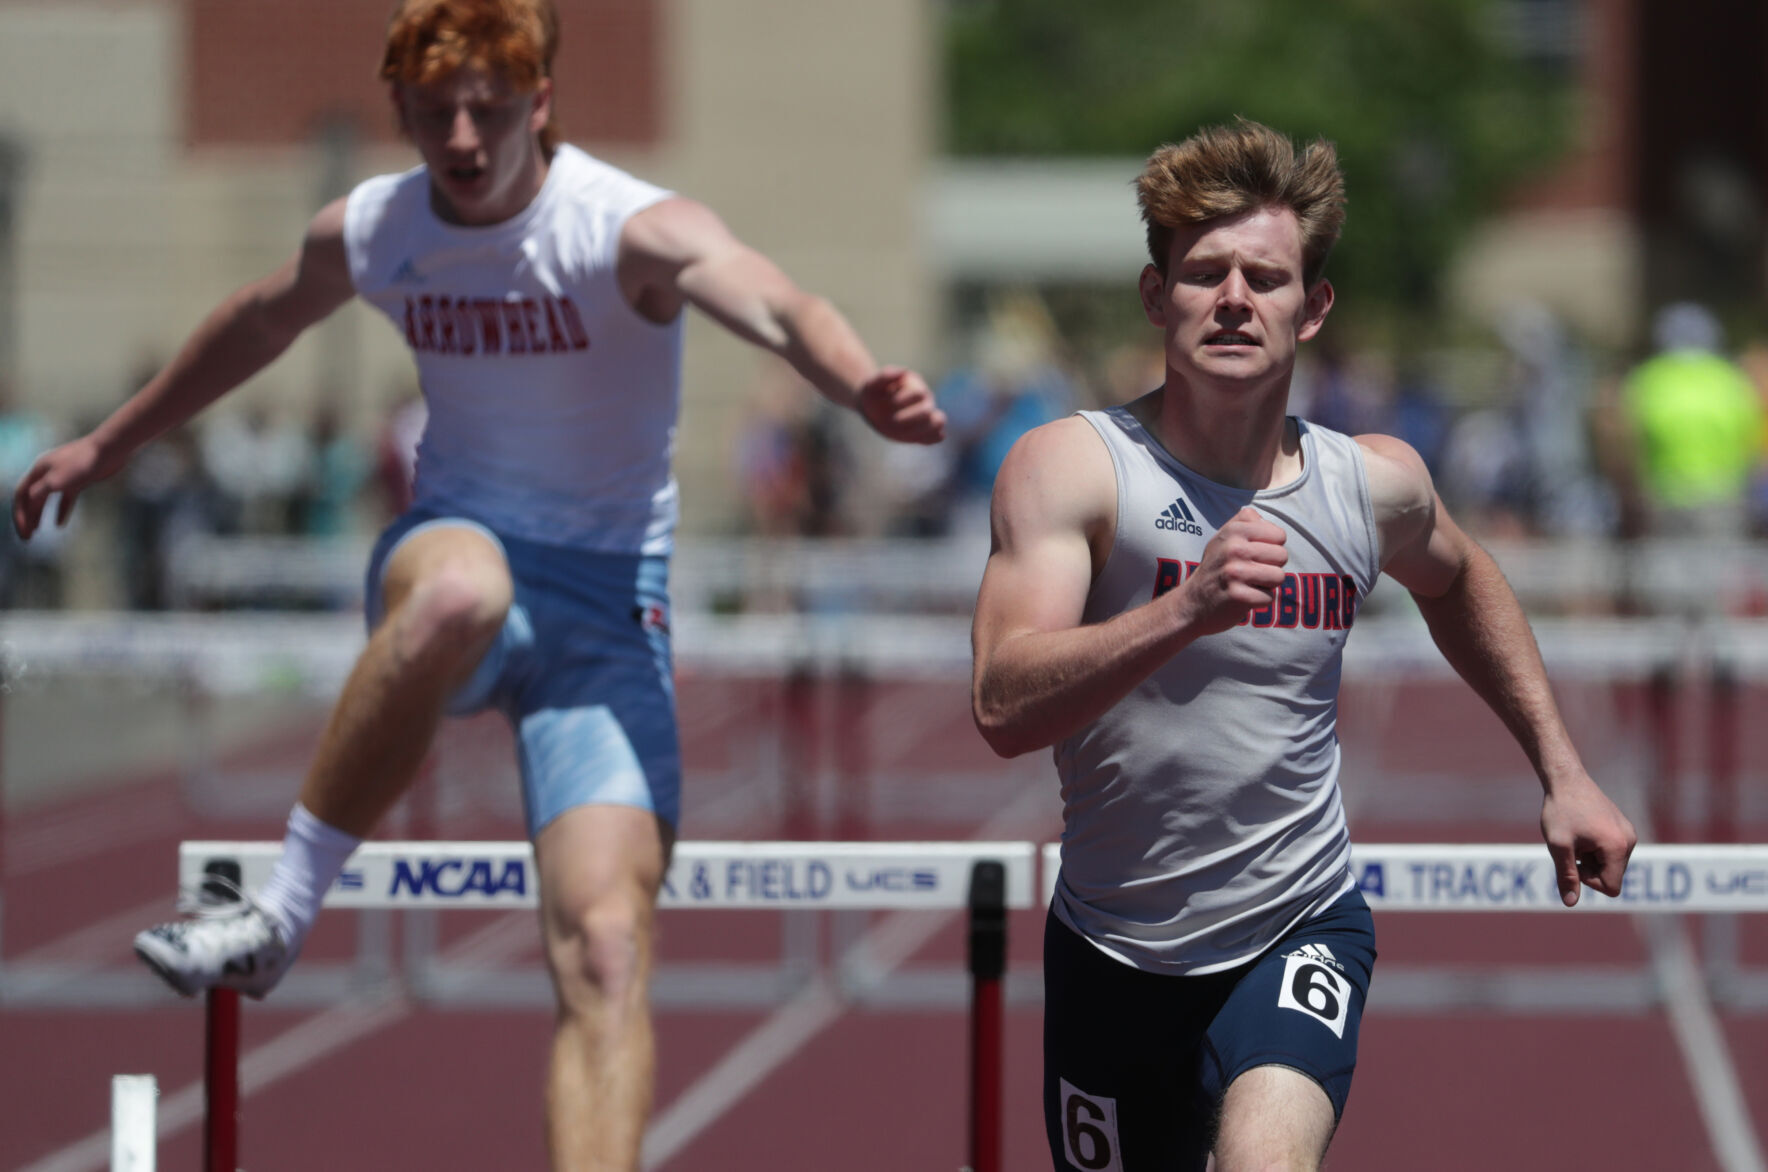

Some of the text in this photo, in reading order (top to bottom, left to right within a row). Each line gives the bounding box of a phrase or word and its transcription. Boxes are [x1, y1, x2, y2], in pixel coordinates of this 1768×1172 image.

[403, 294, 591, 356] ARROWHEAD
[1154, 515, 1203, 537] adidas
[1152, 556, 1357, 631] RBURG
[389, 860, 527, 897] NCAA
[725, 860, 833, 900] FIELD
[1408, 862, 1538, 900] TRACK
[1291, 963, 1341, 1021] 6
[1066, 1093, 1112, 1170] 6
